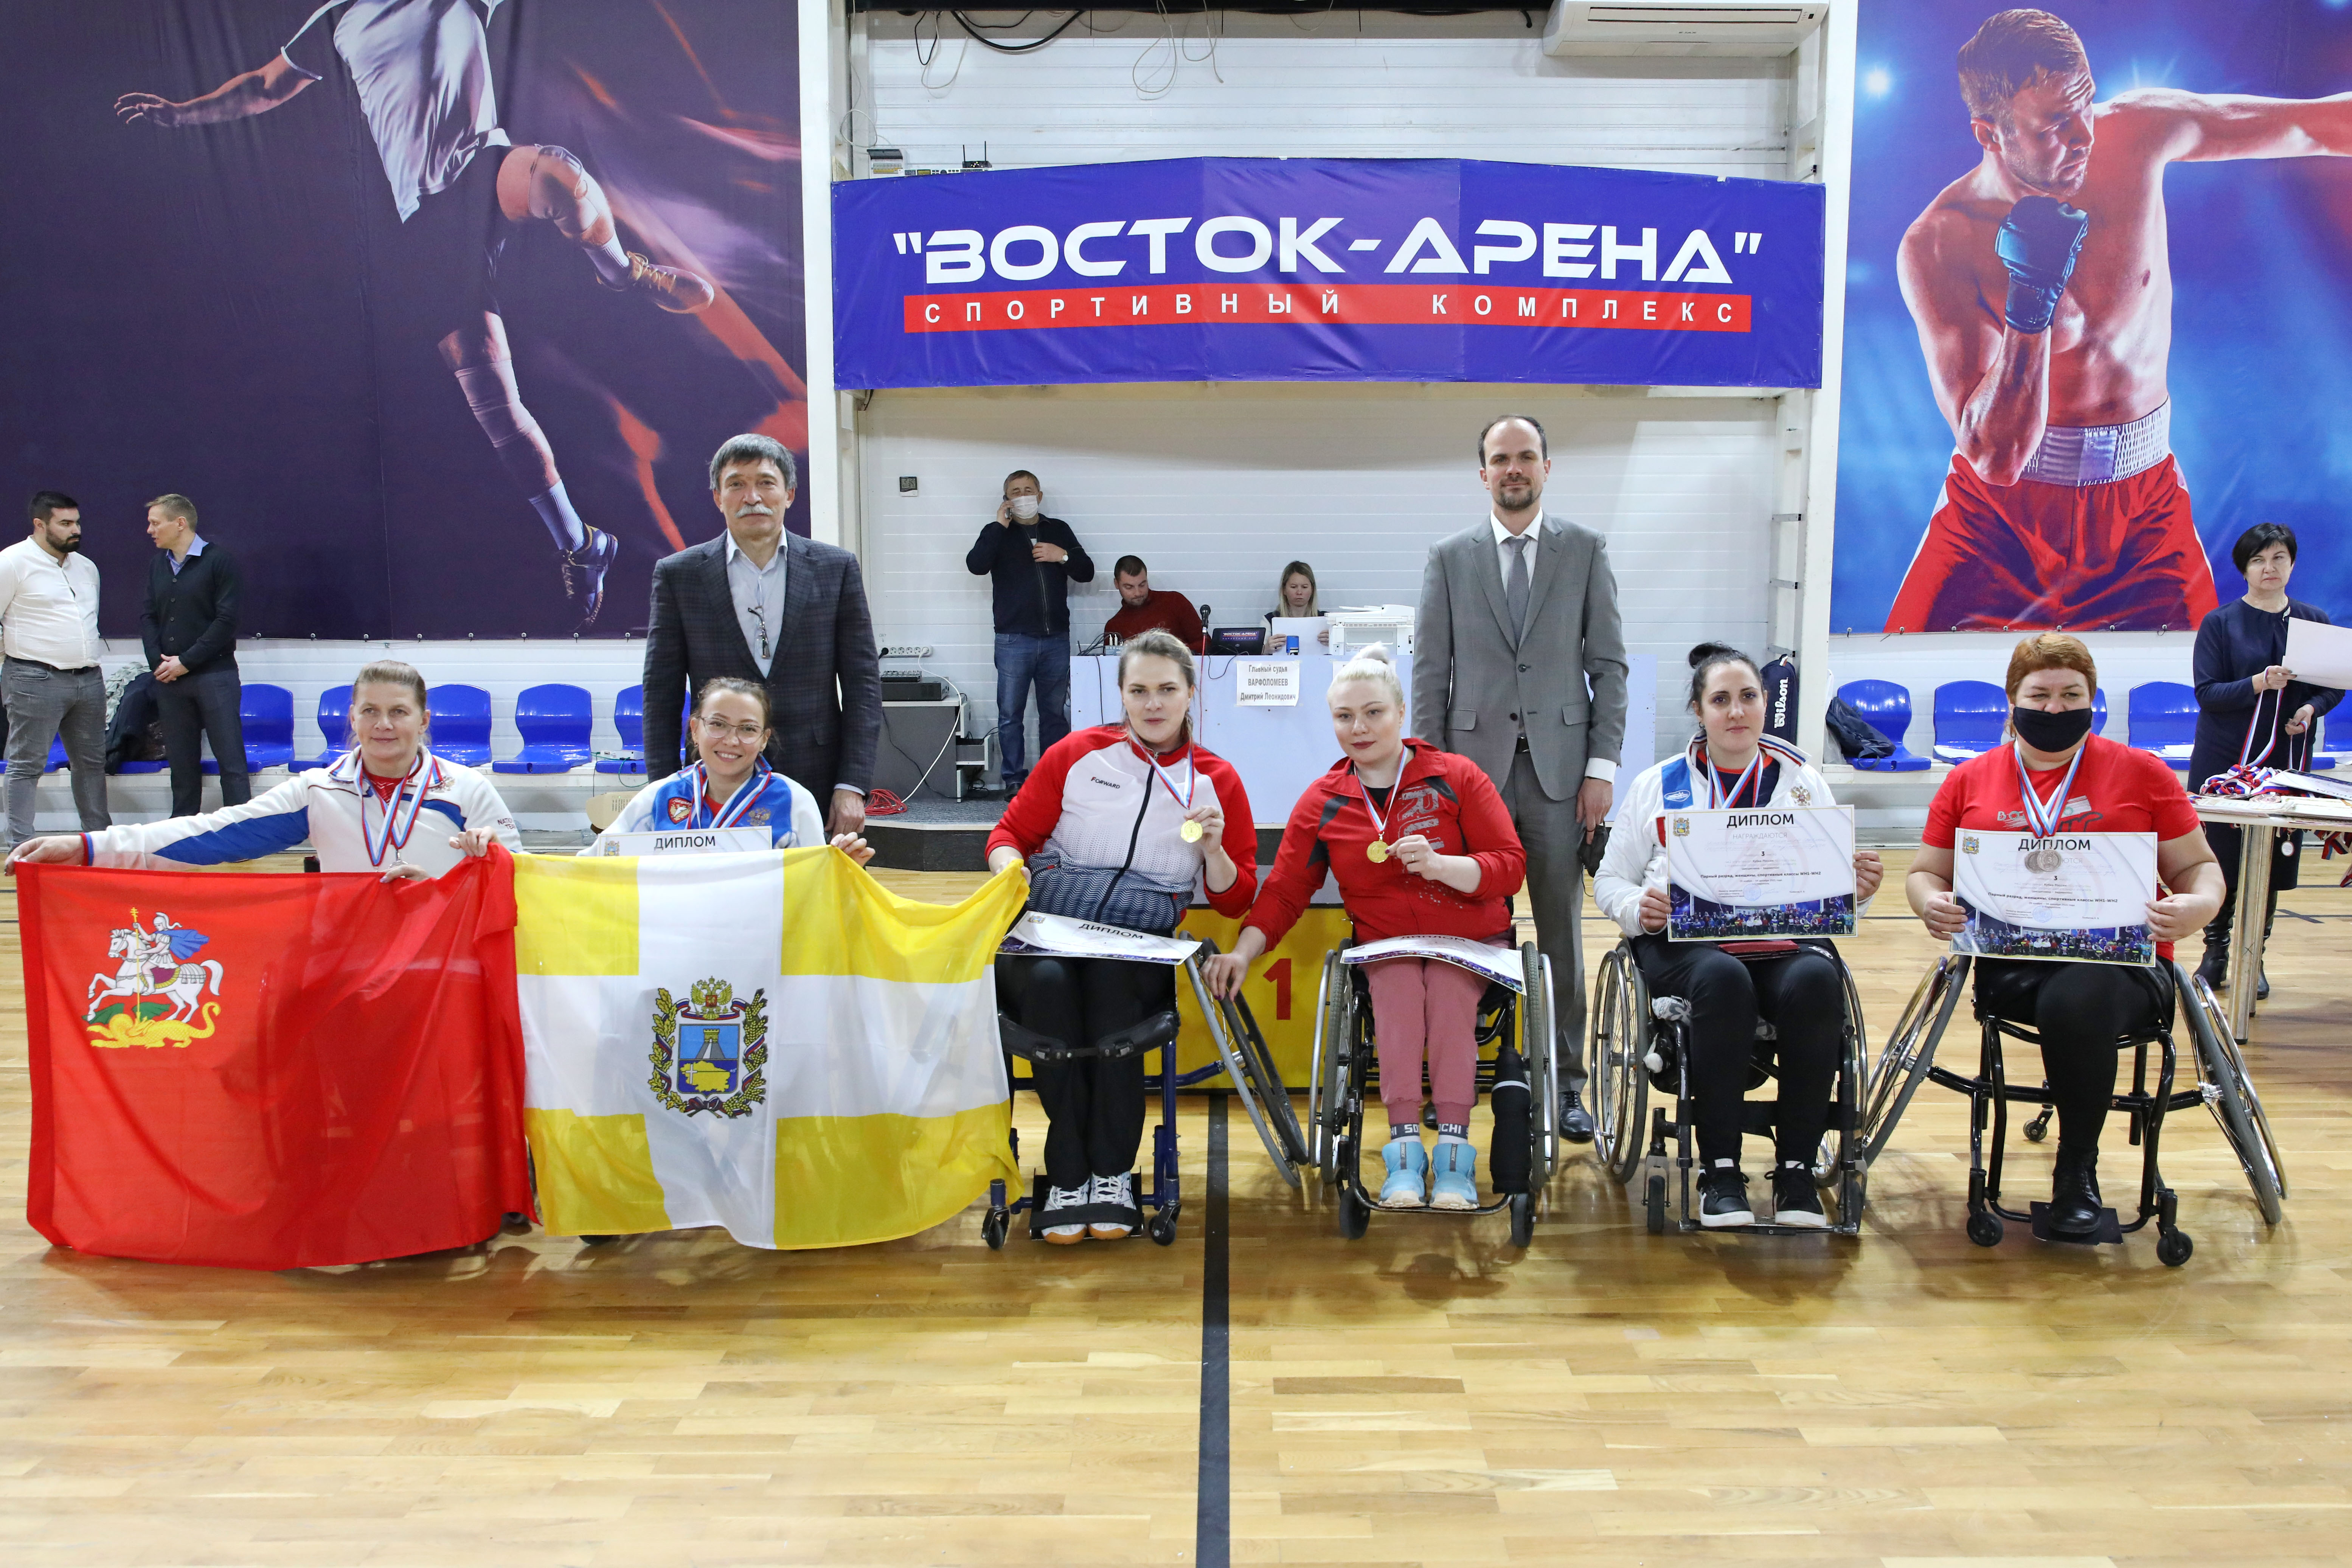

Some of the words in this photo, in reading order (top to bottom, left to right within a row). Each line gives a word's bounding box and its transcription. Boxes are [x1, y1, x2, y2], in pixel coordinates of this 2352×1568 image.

[925, 289, 1338, 323] СПОРТИВНЫЙ
[1433, 294, 1732, 323] КОМПЛЕКС
[1248, 678, 1288, 686] ВАРФОЛОМЕЕВ
[1240, 692, 1263, 701] Дмитрий
[1774, 677, 1788, 728] Wilson
[1091, 776, 1120, 789] FORWARD
[1726, 813, 1794, 828] ДИПЛОМ
[654, 836, 715, 851] ДИПЛОМ
[2018, 839, 2090, 851] ДИПЛОМ
[1079, 924, 1143, 939] ДИПЛОМ
[1263, 958, 1291, 1020] 1
